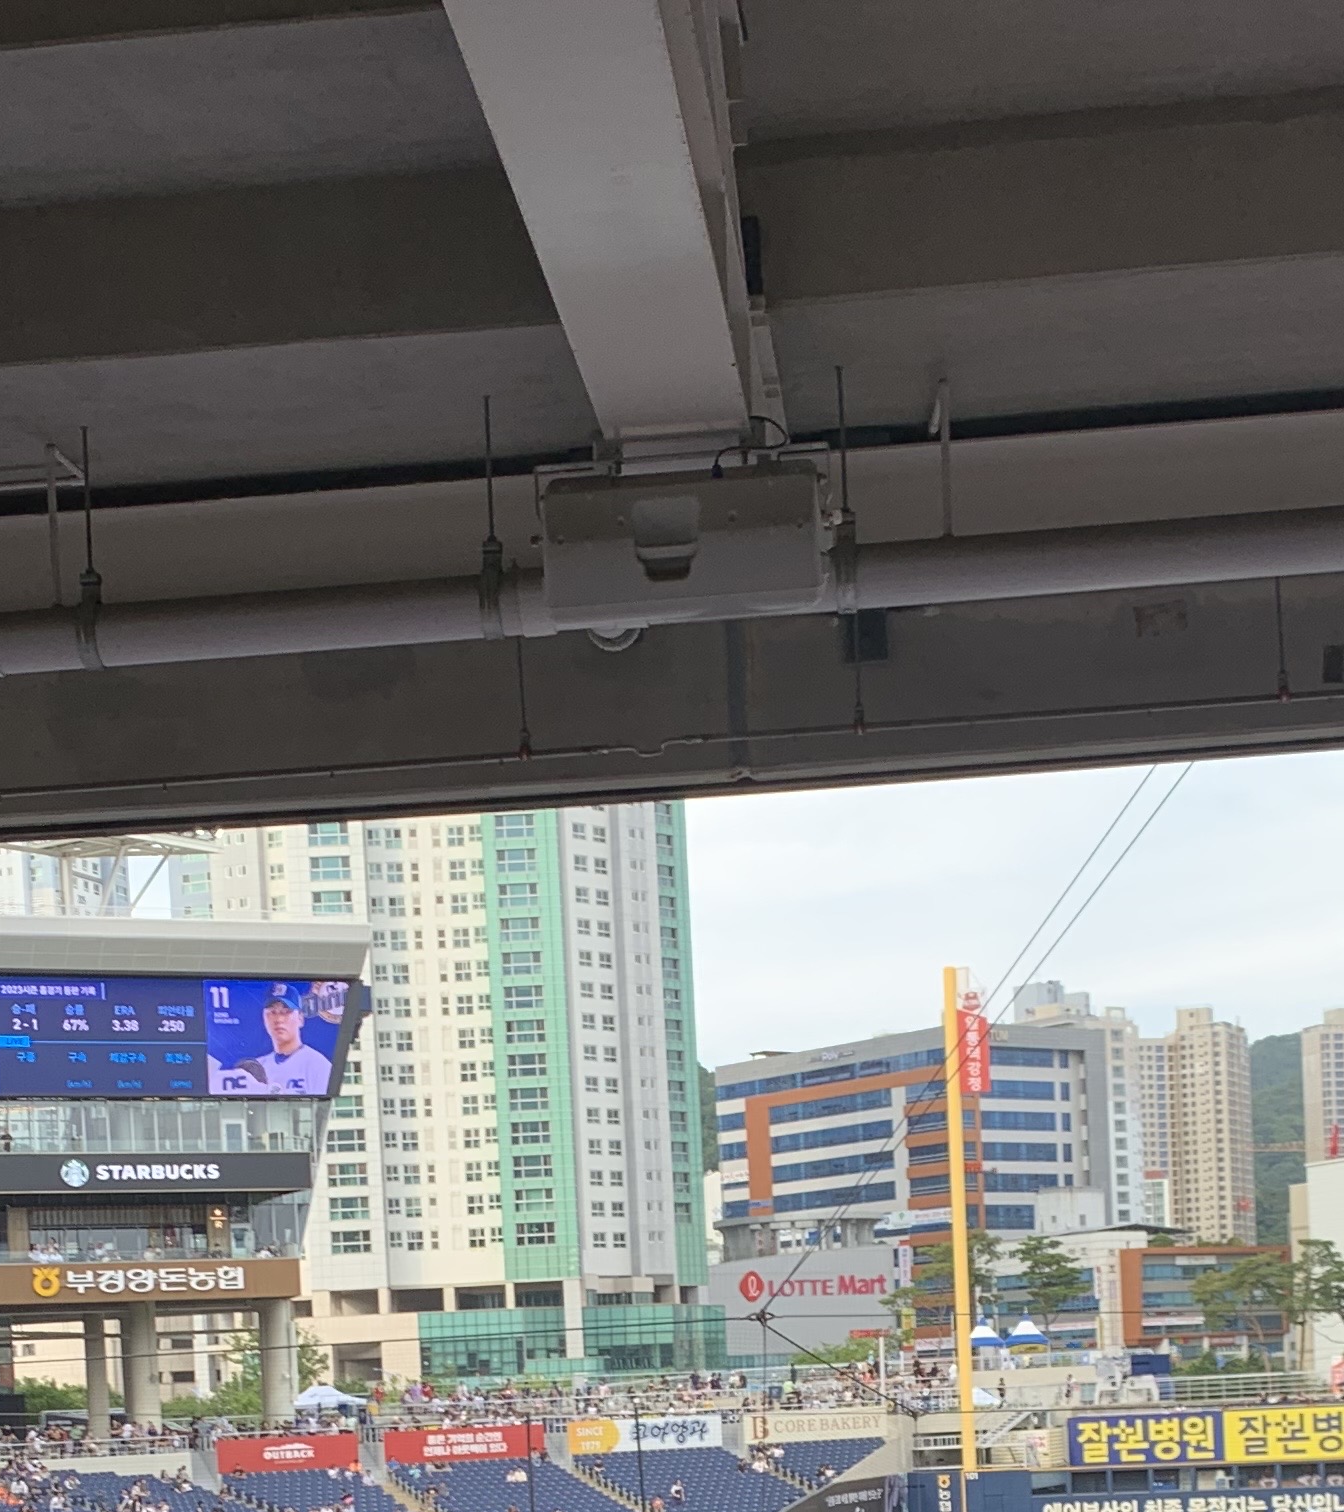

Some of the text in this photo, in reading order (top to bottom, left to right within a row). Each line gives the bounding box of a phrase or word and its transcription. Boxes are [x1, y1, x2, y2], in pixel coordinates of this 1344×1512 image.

[209, 986, 230, 1009] 11
[114, 1005, 135, 1016] ERA
[62, 1018, 89, 1031] 67%
[112, 1019, 139, 1032] 3.38
[158, 1019, 185, 1032] .250
[96, 1163, 221, 1181] STARBUCKS
[66, 1266, 245, 1294] 부경양돈농협
[768, 1274, 887, 1298] LOTTE Mart
[576, 1426, 603, 1437] SINCE
[774, 1414, 882, 1433] CORE BAKERY
[263, 1448, 315, 1460] OUTBACK
